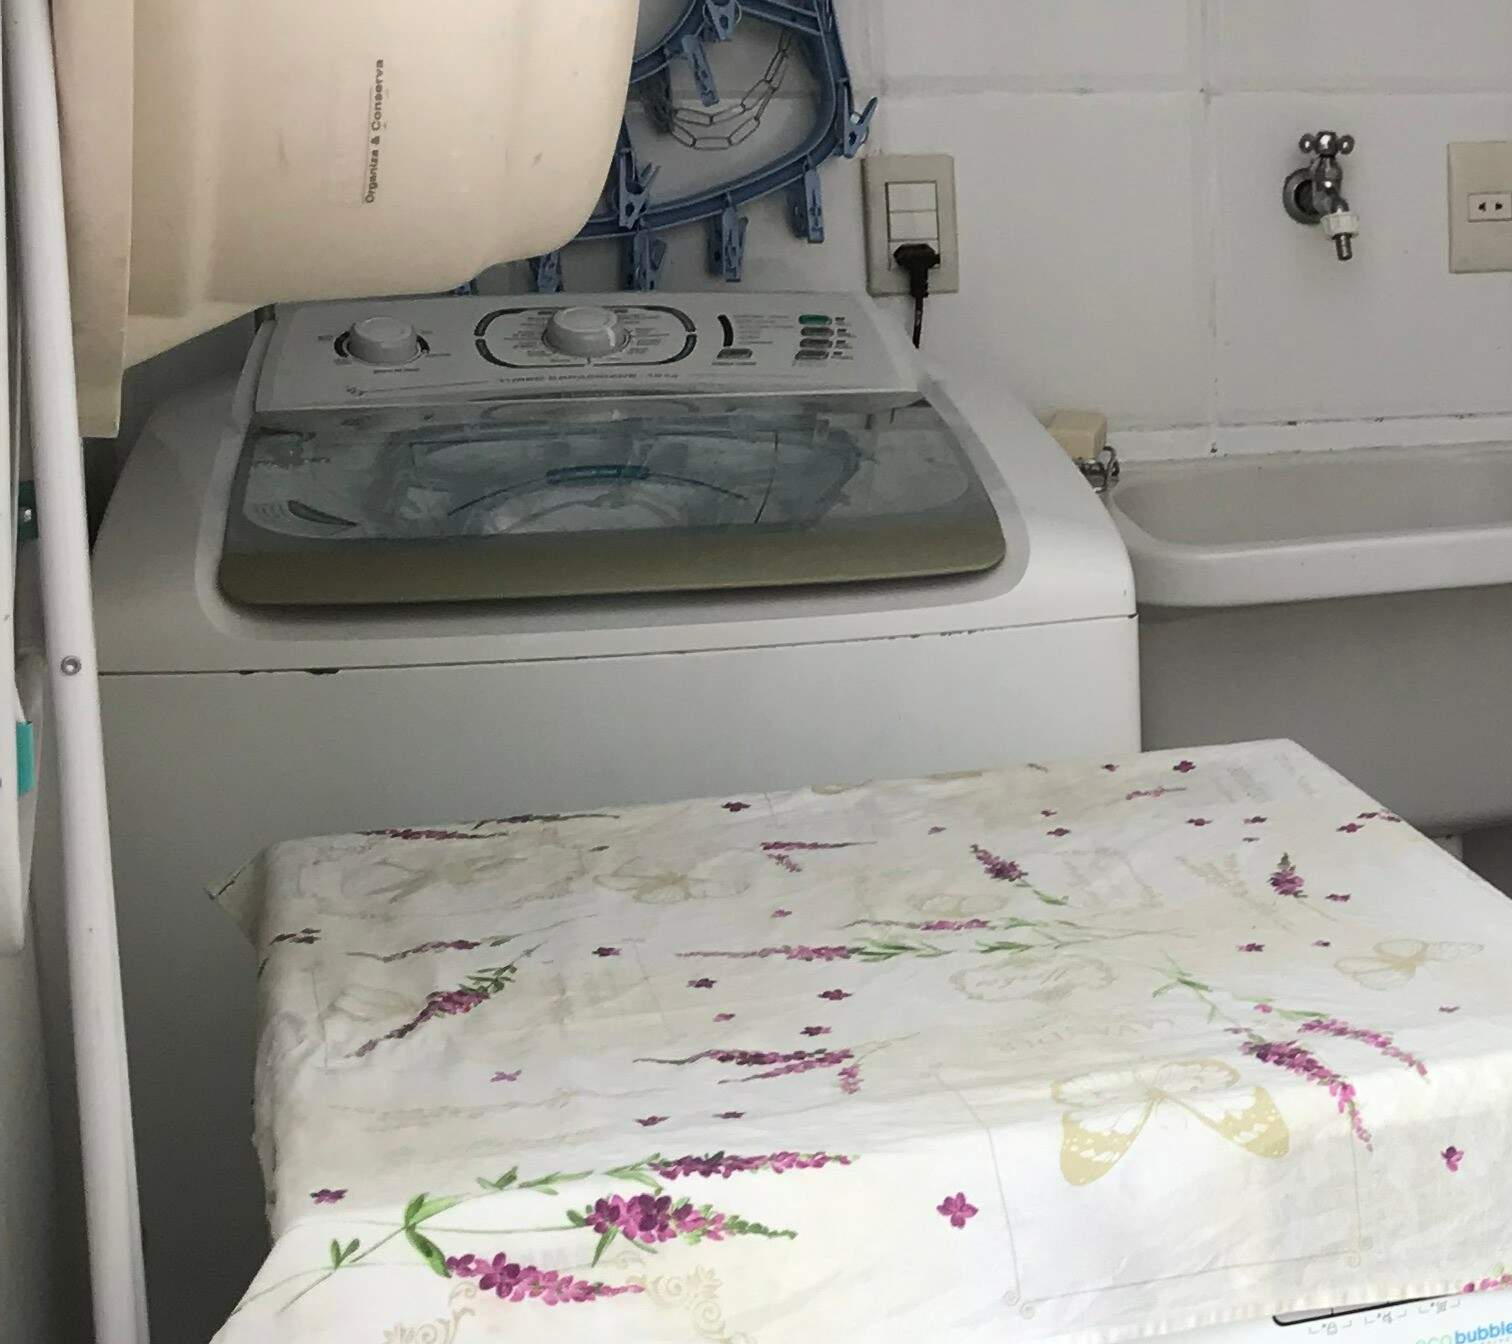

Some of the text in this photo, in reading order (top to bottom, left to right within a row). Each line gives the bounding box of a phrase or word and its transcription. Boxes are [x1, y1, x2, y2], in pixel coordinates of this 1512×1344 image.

[364, 58, 384, 204] Organiza & Conserva
